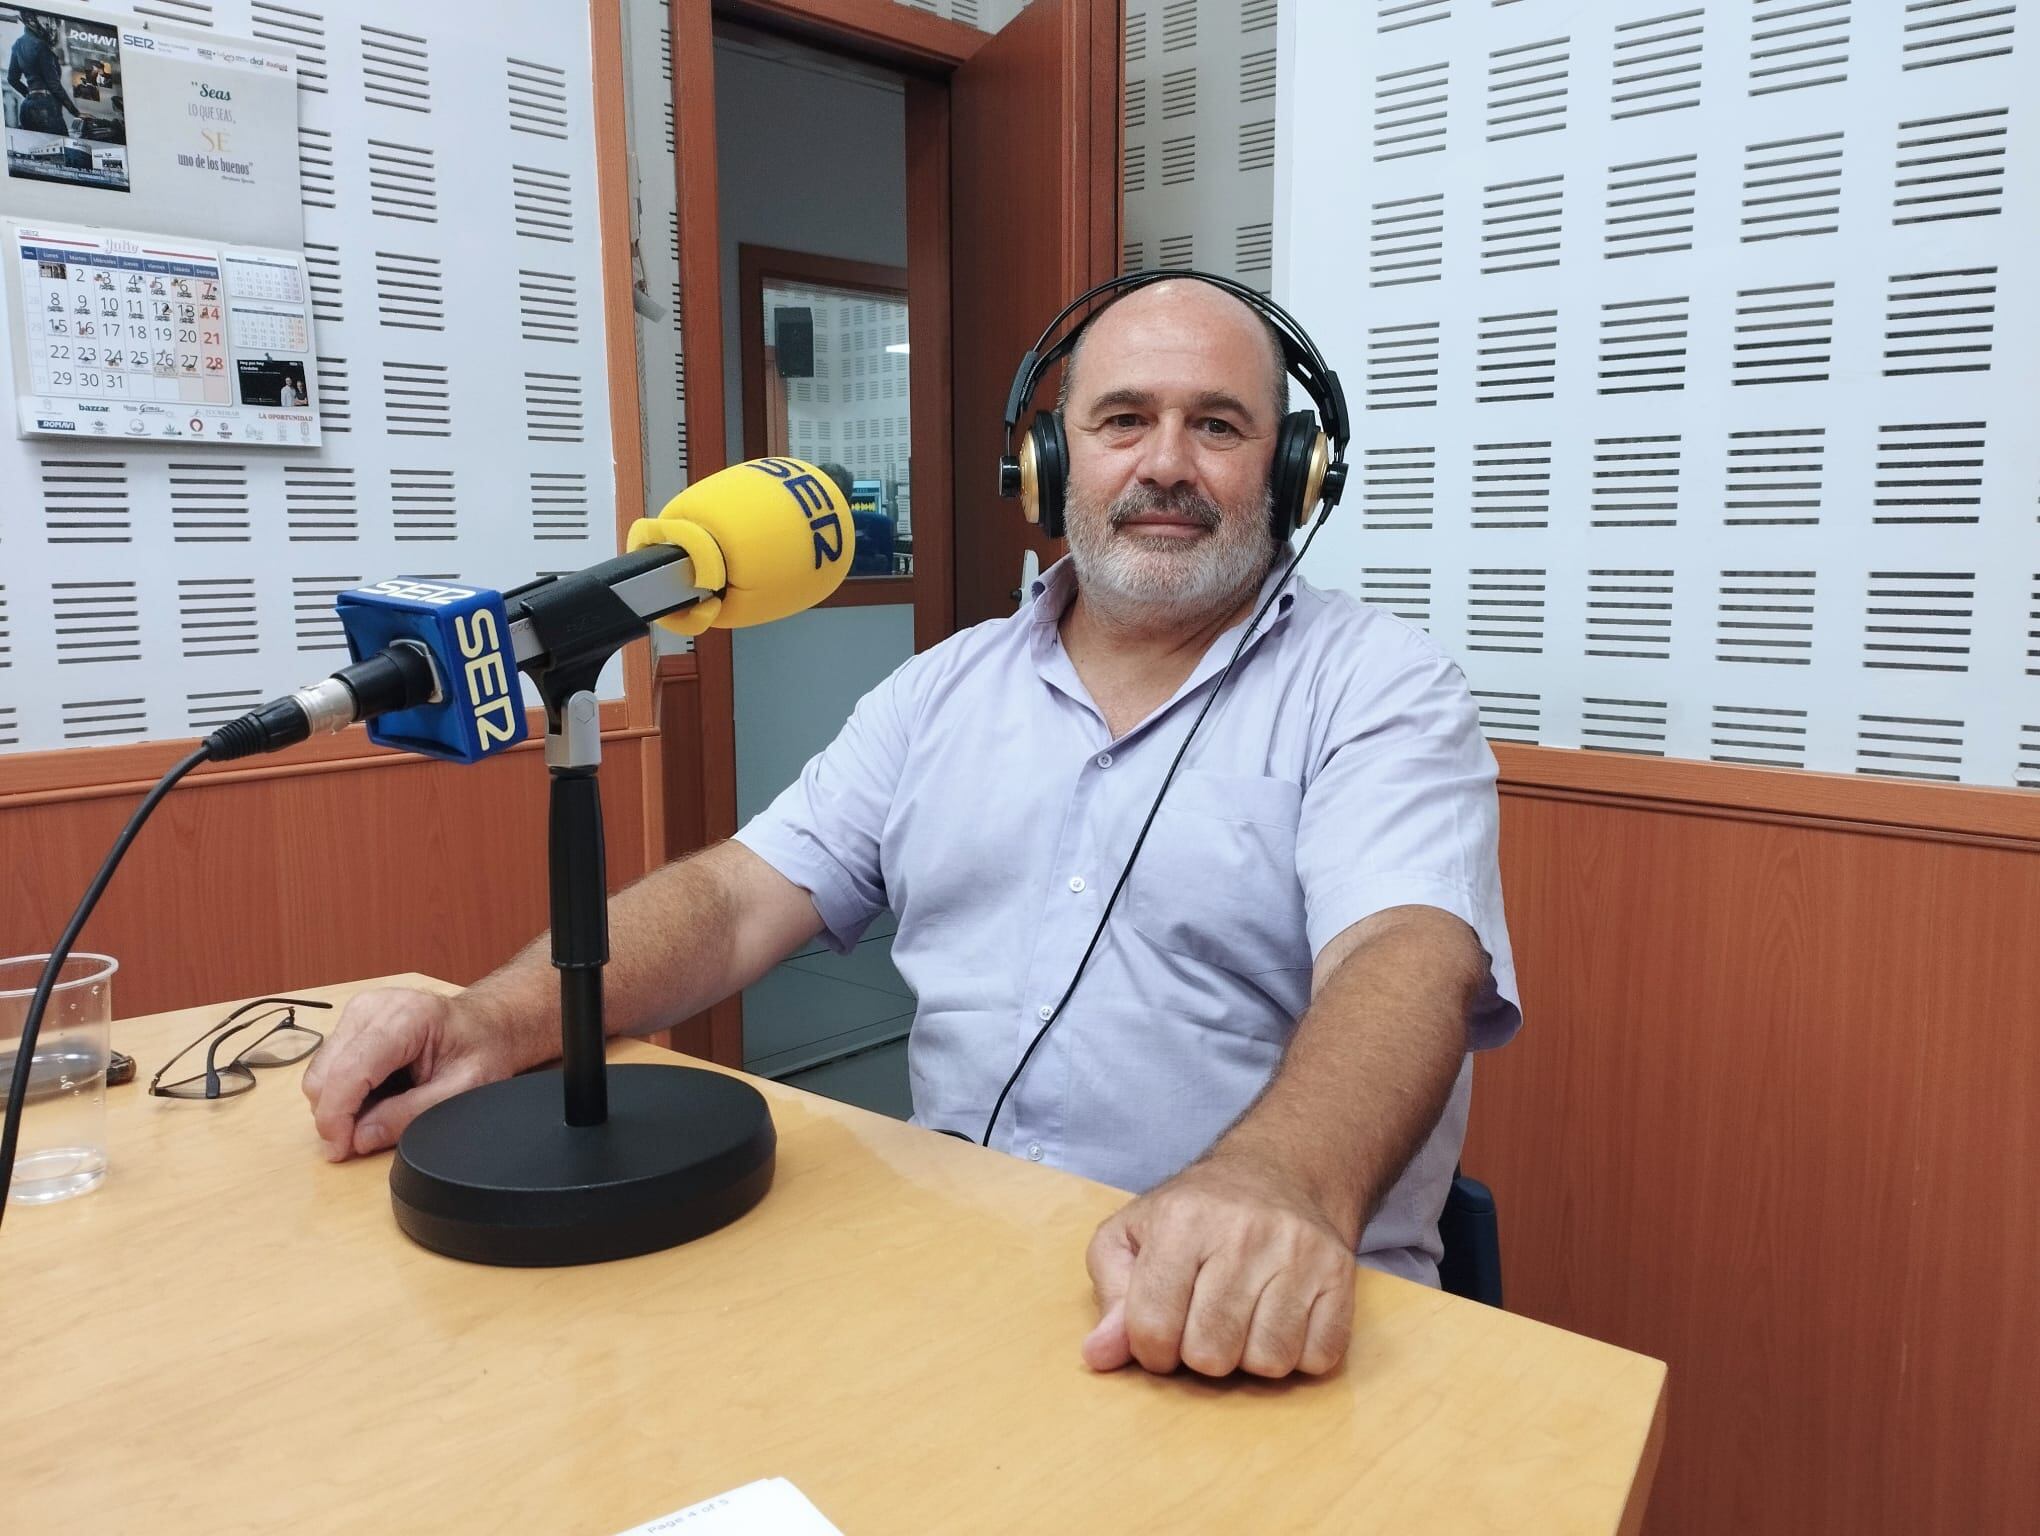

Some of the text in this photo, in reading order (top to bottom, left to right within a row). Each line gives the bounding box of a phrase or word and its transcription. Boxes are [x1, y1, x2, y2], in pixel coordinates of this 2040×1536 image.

[70, 29, 117, 47] ROMAVI
[123, 34, 155, 50] SER
[250, 56, 264, 66] dial
[188, 103, 198, 117] LO
[200, 104, 215, 121] QUE
[178, 153, 194, 167] uno
[195, 153, 206, 169] de
[206, 155, 219, 171] los
[75, 268, 86, 283] 2
[102, 270, 112, 286] 3
[128, 274, 138, 289] 4
[153, 276, 163, 291] 5
[179, 279, 189, 294] 6
[202, 282, 213, 298] 7
[50, 292, 60, 306] 8
[77, 295, 87, 309] 9
[101, 297, 119, 311] 10
[127, 300, 143, 314] 11
[153, 302, 169, 317] 12
[178, 304, 195, 319] 13
[49, 319, 68, 334] 15
[76, 321, 95, 336] 16
[102, 323, 121, 337] 17
[129, 325, 148, 340] 18
[154, 327, 172, 342] 19
[179, 330, 197, 344] 20
[204, 332, 221, 345] 21
[50, 344, 70, 359] 22
[77, 347, 97, 361] 23
[104, 349, 123, 364] 24
[130, 351, 149, 365] 25
[155, 351, 174, 367] 26
[181, 355, 198, 369] 27
[205, 356, 224, 370] 28
[53, 371, 72, 385] 29
[79, 373, 99, 387] 30
[106, 375, 123, 389] 31
[43, 420, 75, 431] ROMAVI
[743, 458, 843, 570] SER
[358, 579, 477, 605] SER
[454, 608, 516, 751] SER
[647, 1517, 683, 1534] Page
[701, 1503, 715, 1513] of
